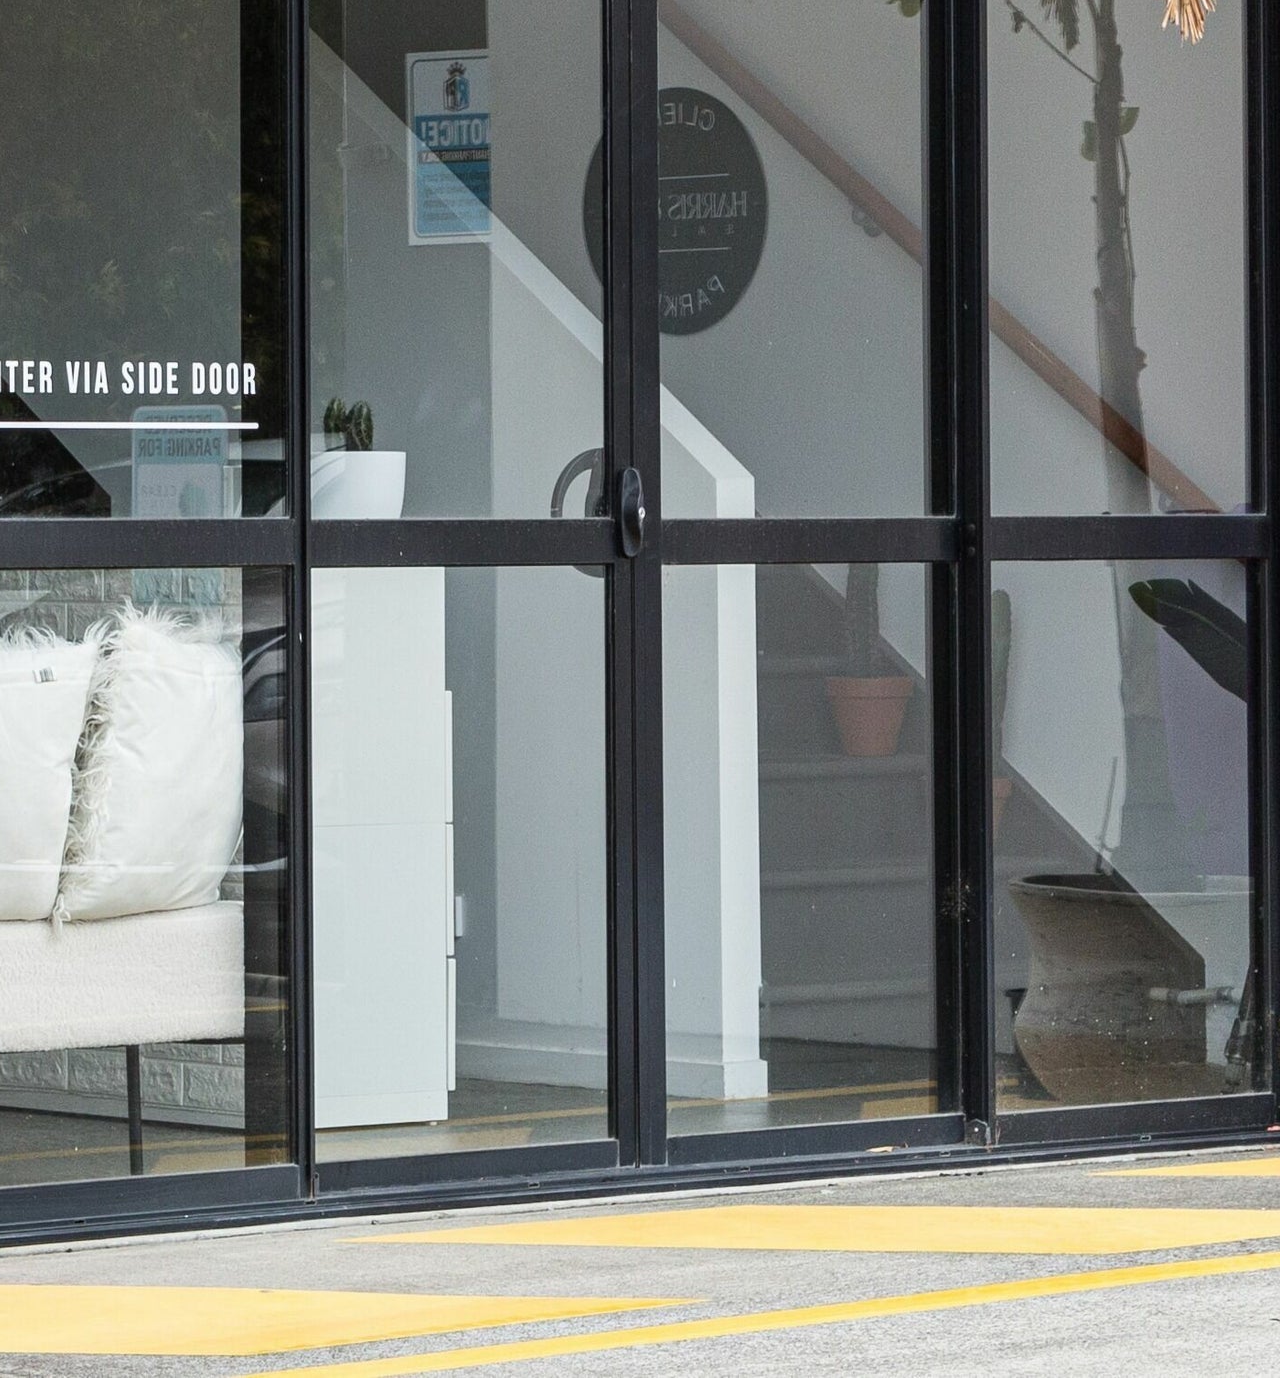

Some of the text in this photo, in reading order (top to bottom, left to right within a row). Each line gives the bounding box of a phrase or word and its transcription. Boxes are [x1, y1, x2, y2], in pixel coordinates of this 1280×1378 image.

[65, 361, 109, 394] VIA
[121, 361, 179, 395] SIDE
[192, 362, 256, 395] DOOR
